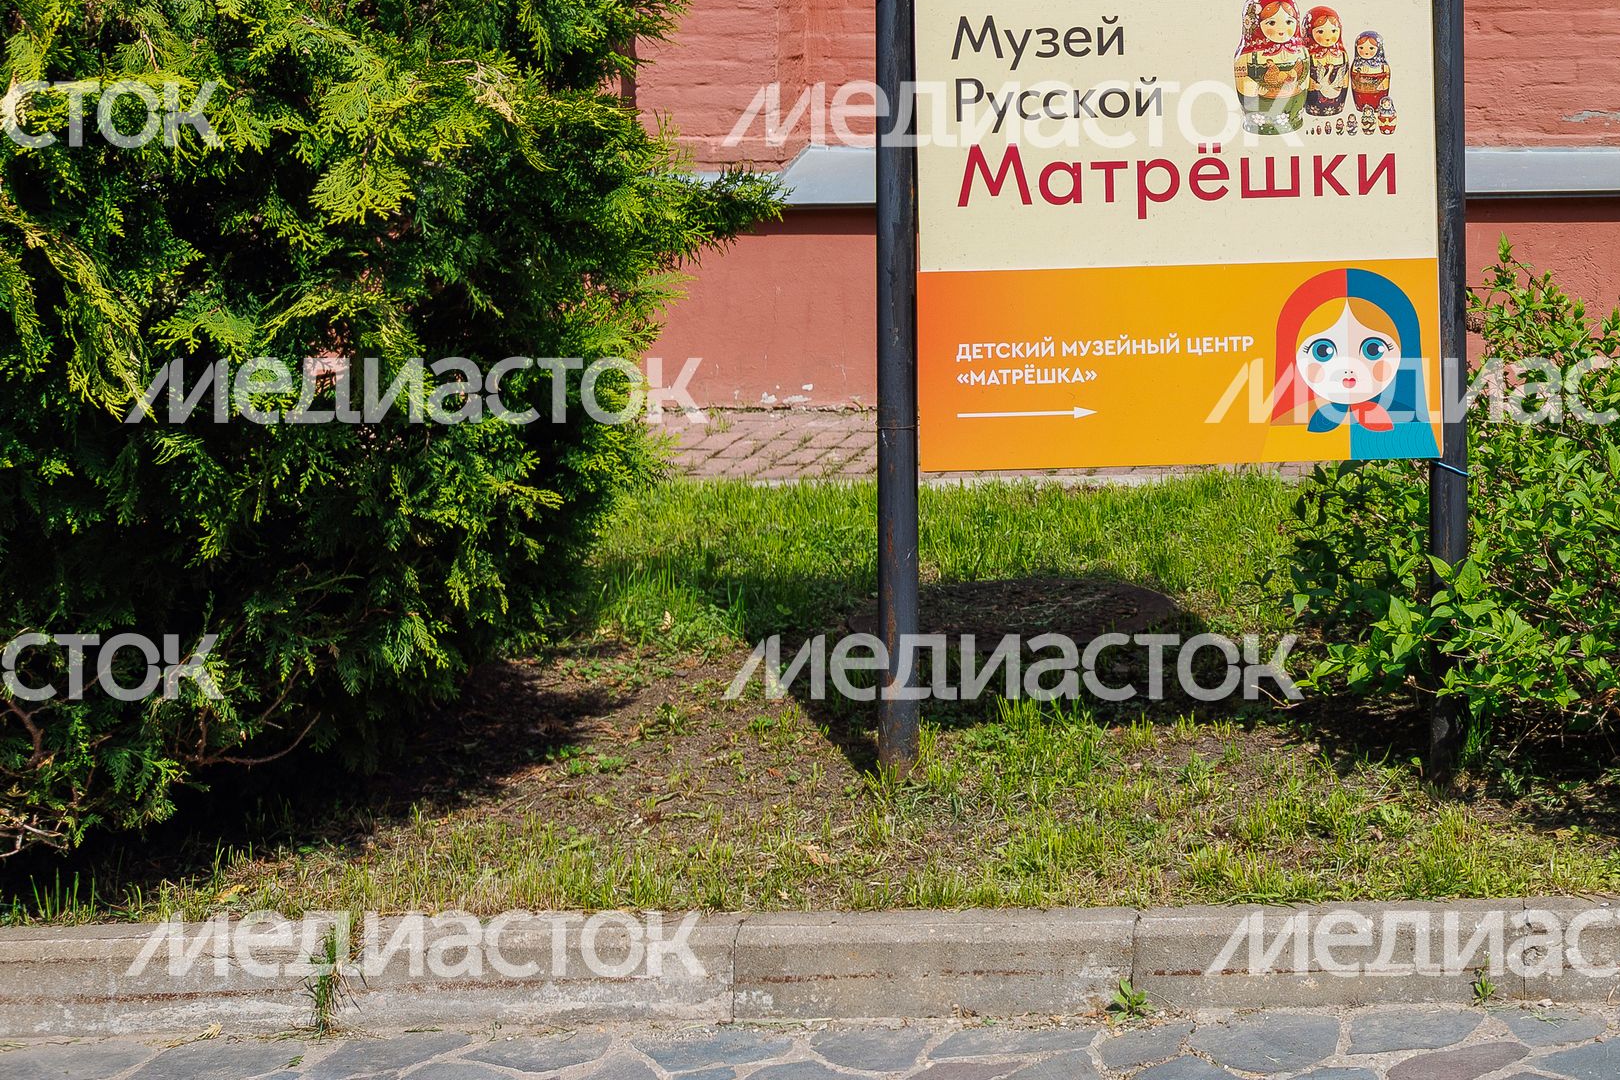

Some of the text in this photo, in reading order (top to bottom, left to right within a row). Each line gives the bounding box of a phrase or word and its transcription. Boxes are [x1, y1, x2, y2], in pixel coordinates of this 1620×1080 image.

[950, 15, 1125, 71] Музей
[955, 76, 1163, 134] Русской
[957, 142, 1397, 220] Матрёшки
[956, 332, 1254, 362] ДЕТСКИЙ МУЗЕЙНЫЙ ЦЕНТР
[956, 364, 1098, 386] «МАТРЁШКА»
